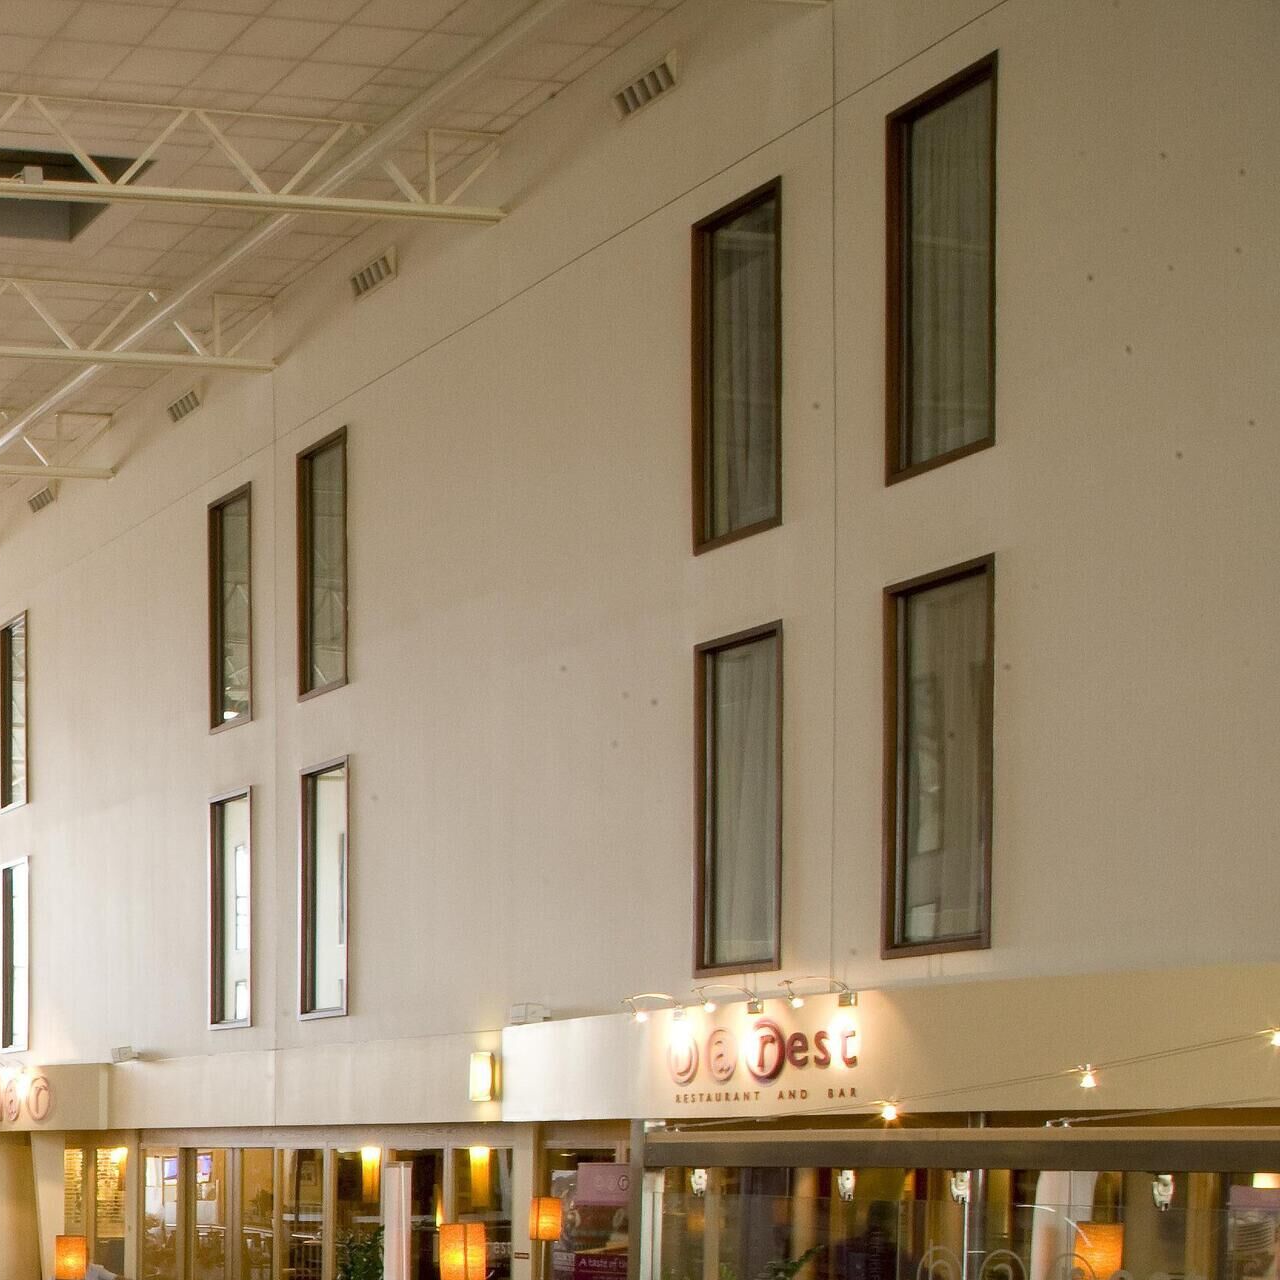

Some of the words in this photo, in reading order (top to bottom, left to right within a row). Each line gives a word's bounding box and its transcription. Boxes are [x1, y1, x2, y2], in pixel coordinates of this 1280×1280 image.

[675, 1090, 761, 1104] RESTAURANT
[778, 1088, 808, 1100] AND
[827, 1087, 857, 1099] BAR
